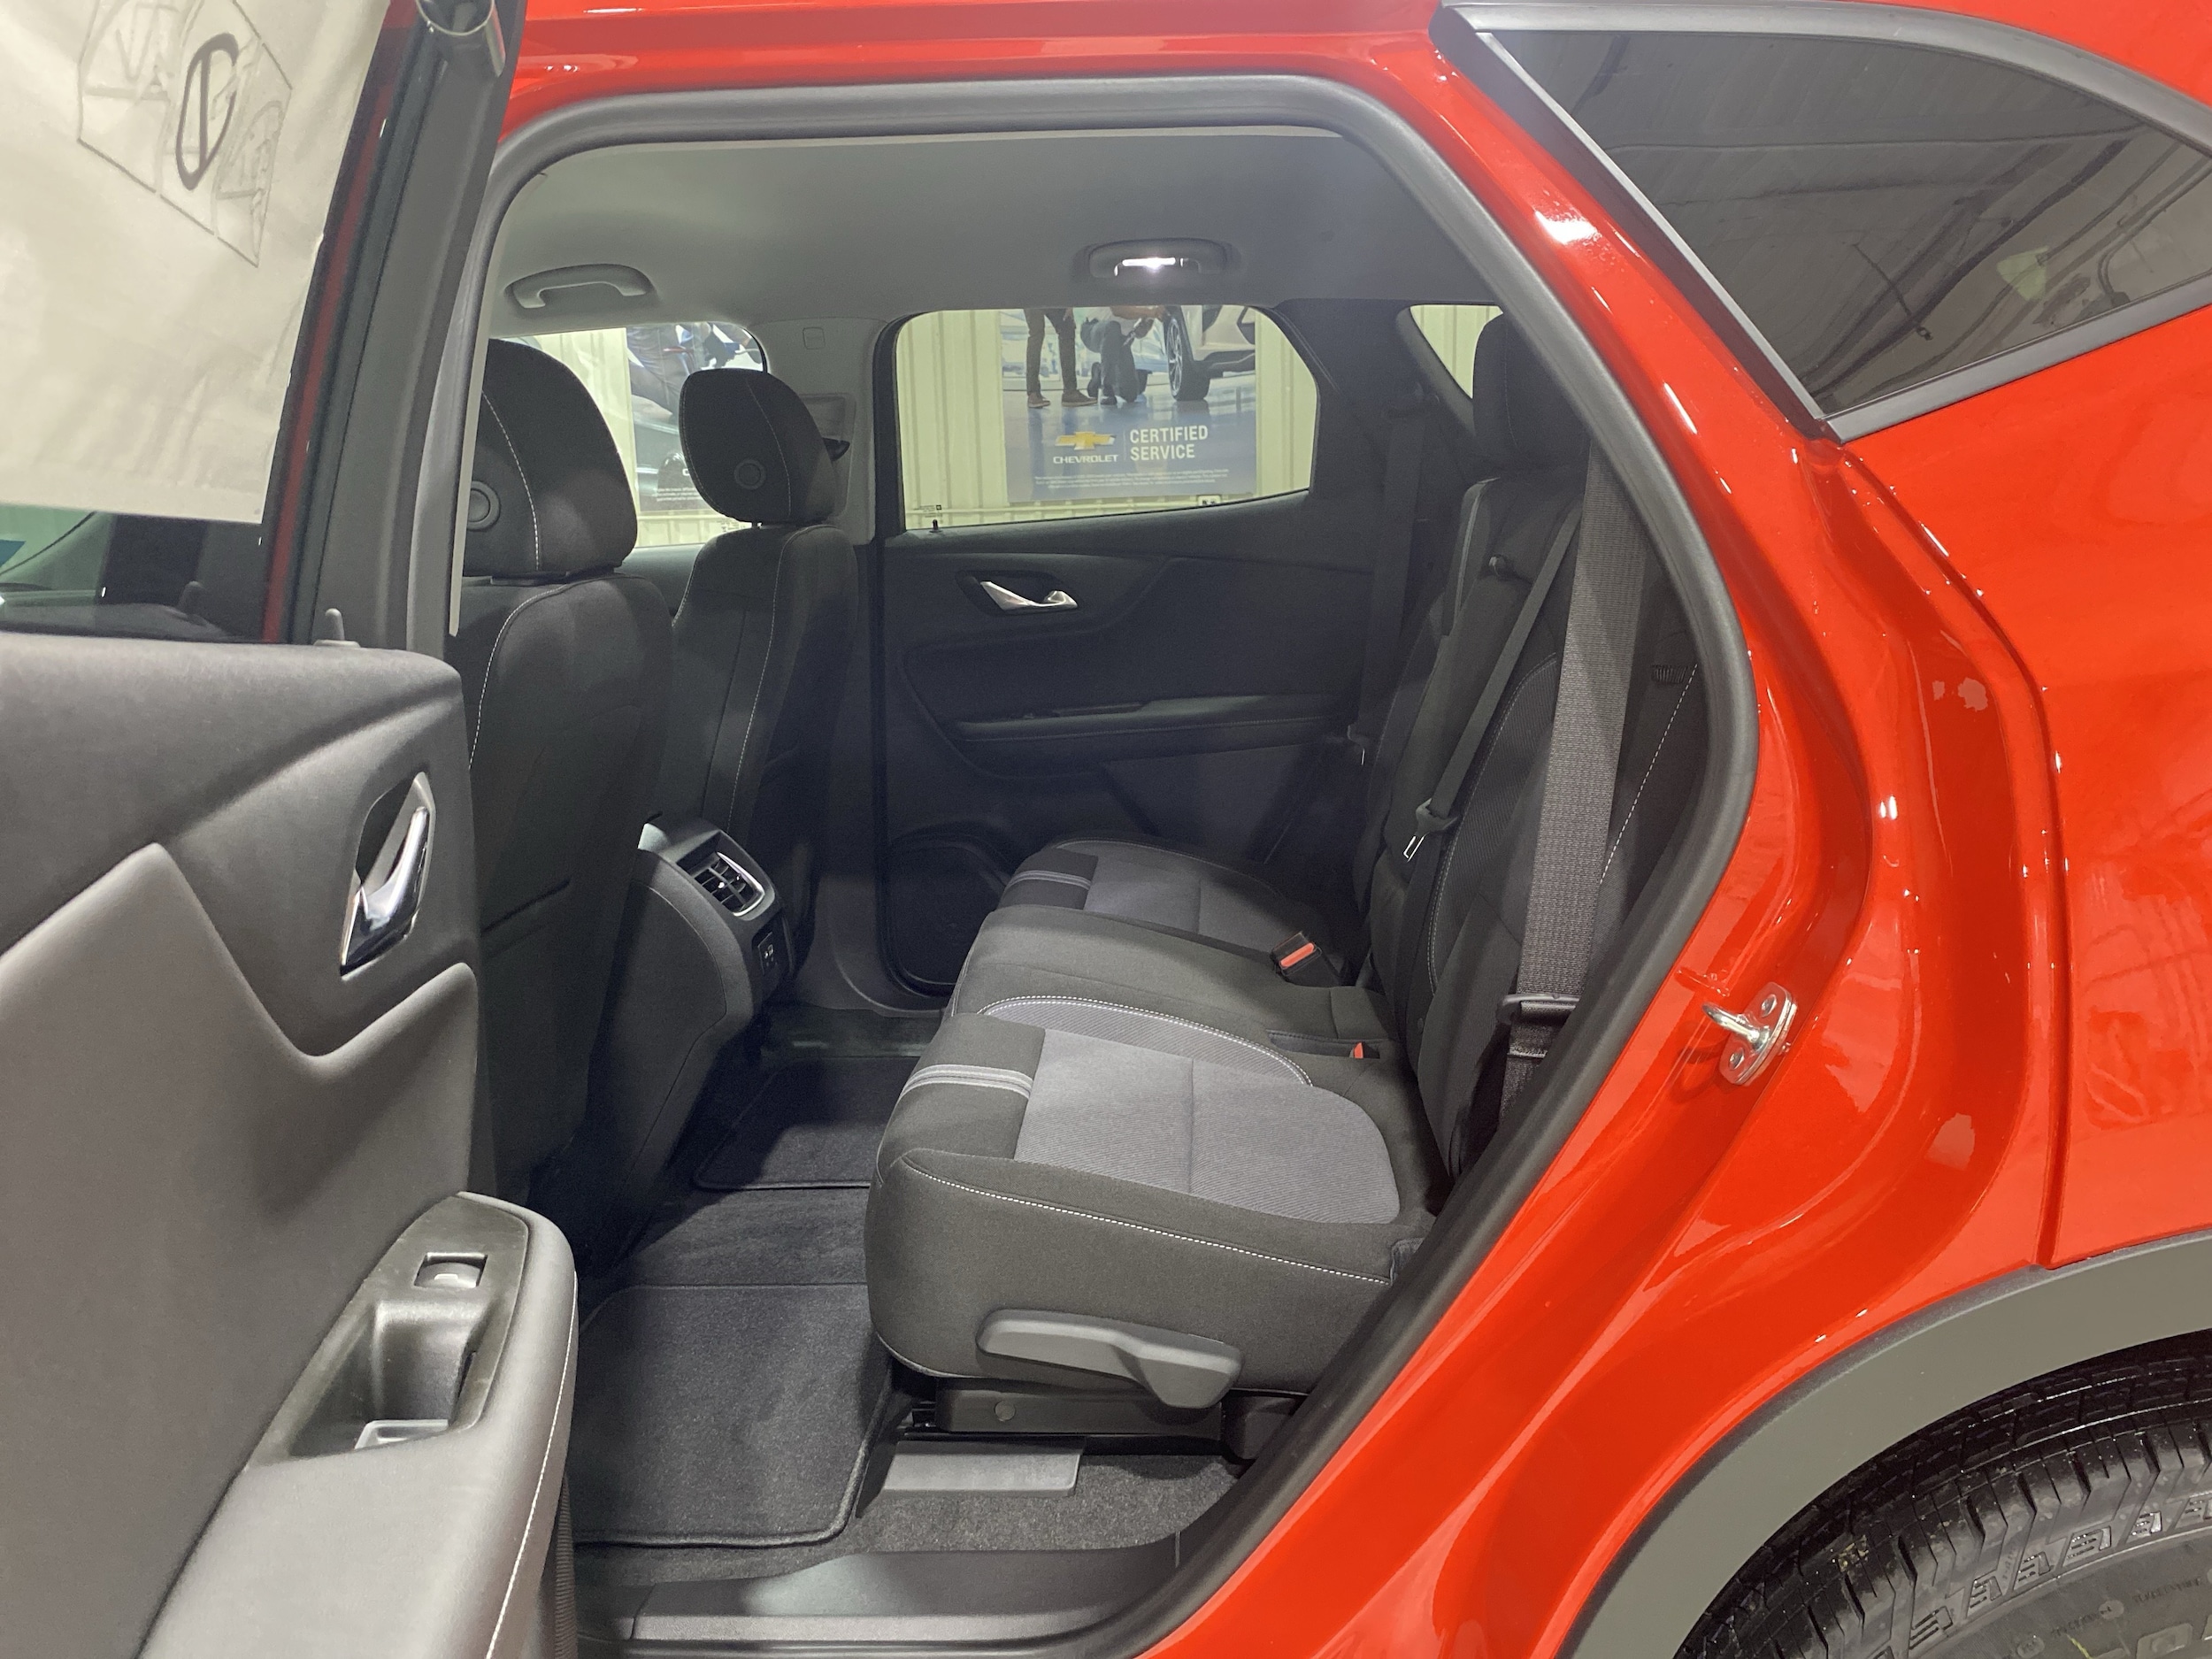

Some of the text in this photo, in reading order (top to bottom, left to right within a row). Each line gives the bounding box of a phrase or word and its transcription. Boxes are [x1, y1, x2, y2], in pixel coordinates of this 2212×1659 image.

[1130, 425, 1209, 443] CERTIFIED
[1052, 454, 1119, 465] CHEVROLET
[1130, 443, 1195, 462] SERVICE
